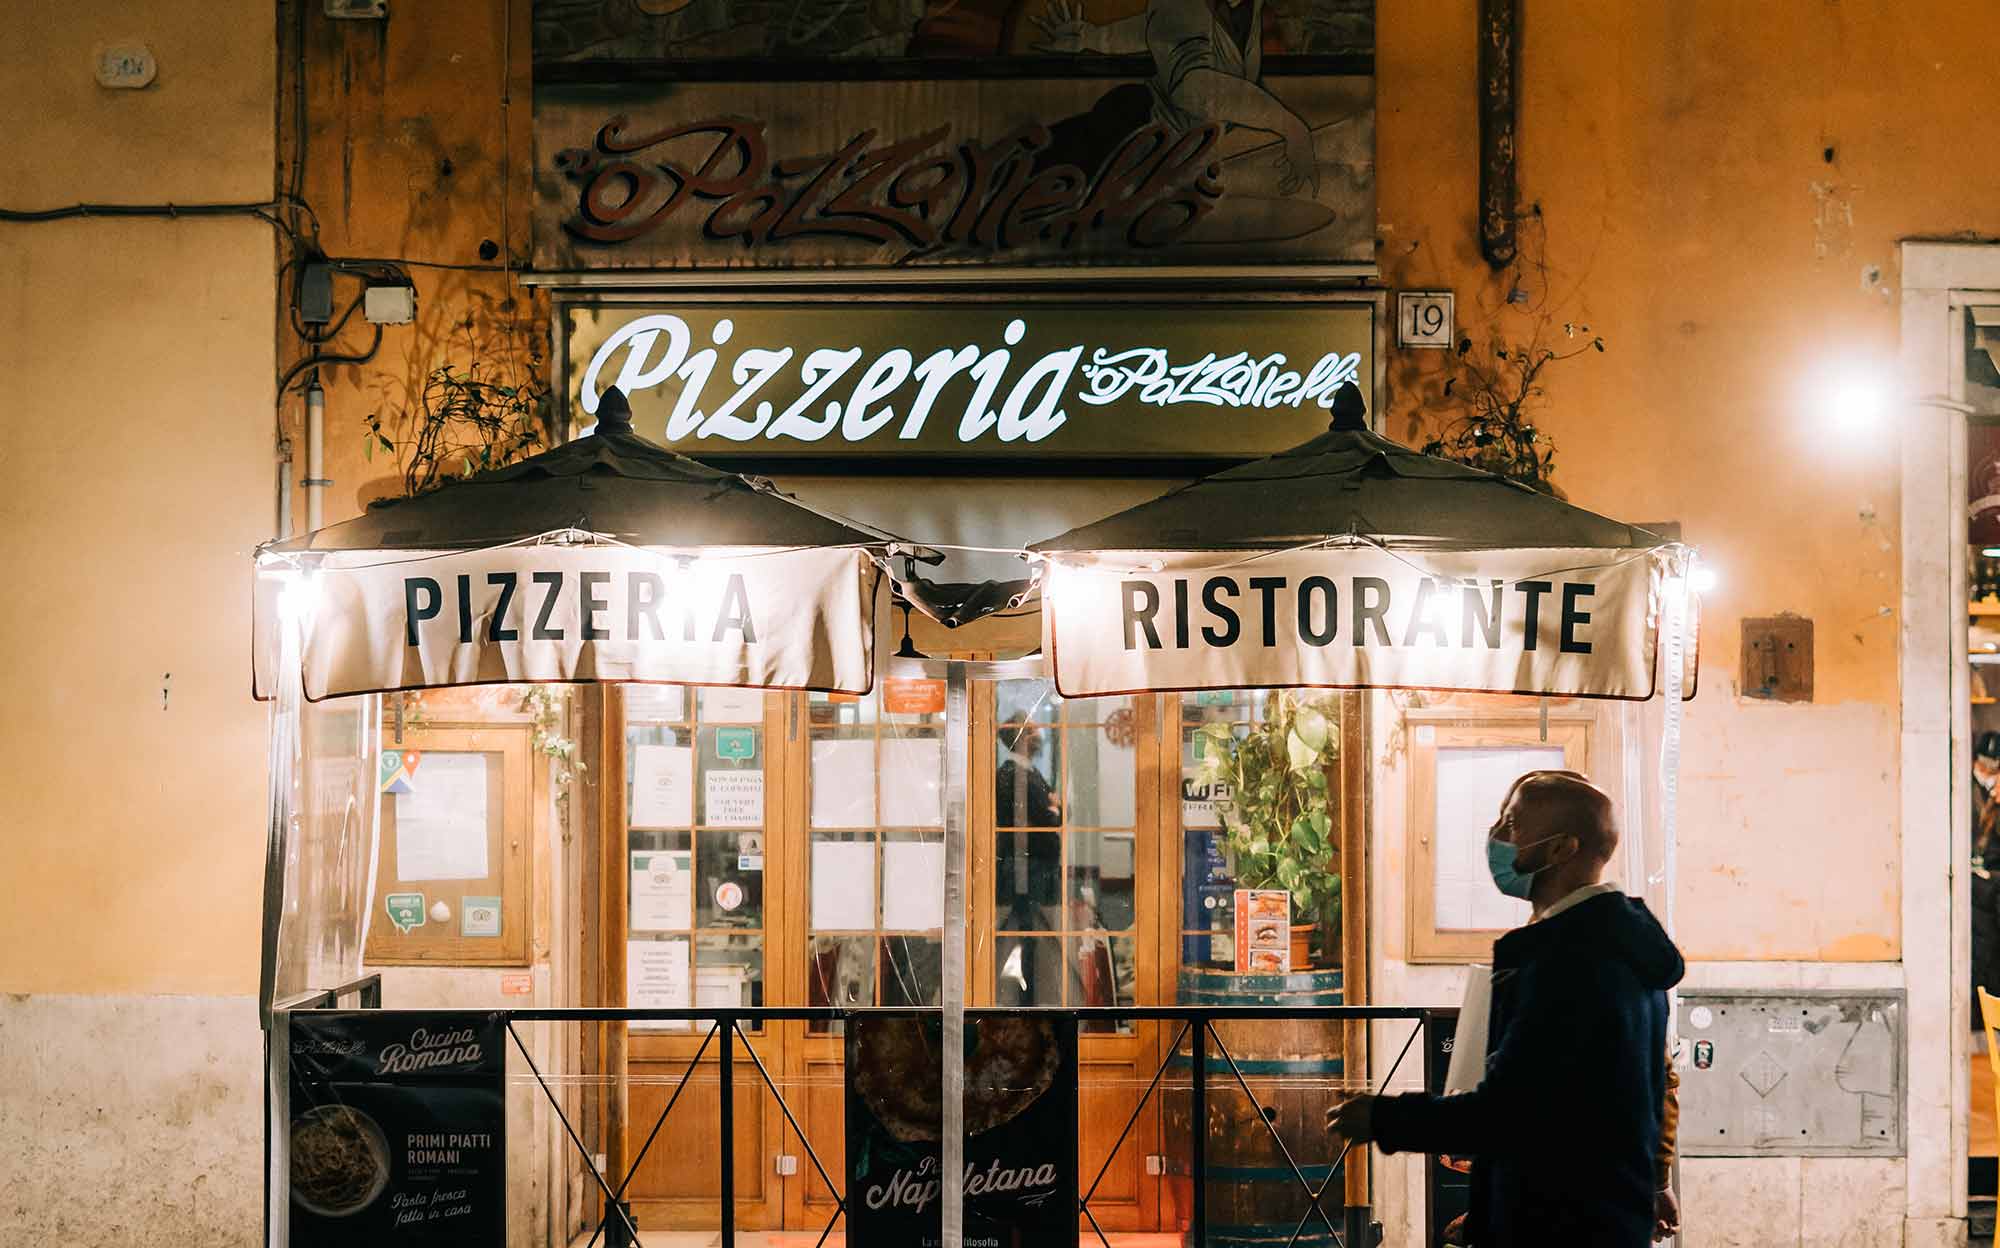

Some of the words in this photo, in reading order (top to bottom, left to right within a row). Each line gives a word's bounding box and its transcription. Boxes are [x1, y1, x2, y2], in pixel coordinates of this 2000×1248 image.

[1412, 303, 1444, 337] 19
[581, 314, 1084, 442] Pizzeria
[1121, 575, 1596, 655] RISTORANTE
[410, 1026, 474, 1050] Cucina
[376, 1043, 483, 1075] Romana
[407, 1133, 445, 1149] PRIMI
[448, 1133, 491, 1149] PIATTI
[407, 1149, 461, 1165] ROMANI
[391, 1191, 427, 1209] Pasta
[866, 1159, 1057, 1214] Napletana
[444, 1203, 471, 1218] casa
